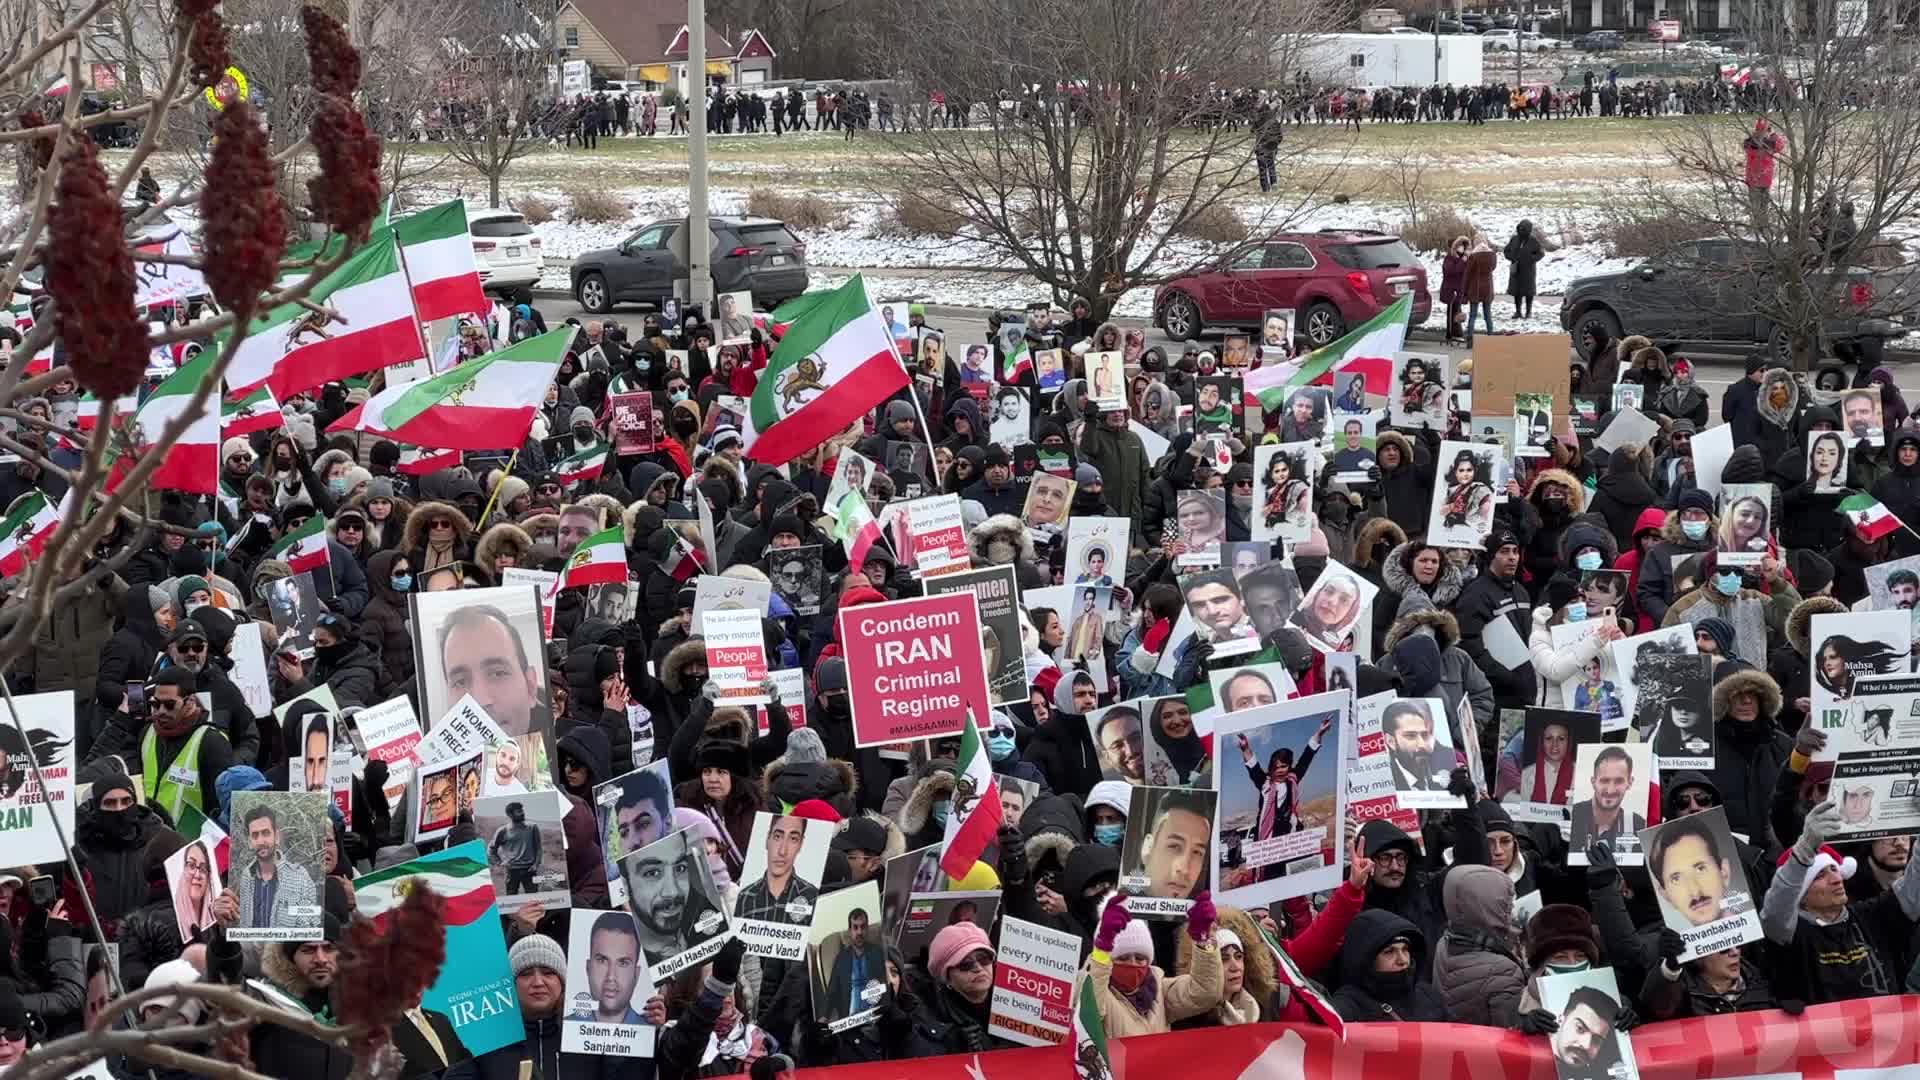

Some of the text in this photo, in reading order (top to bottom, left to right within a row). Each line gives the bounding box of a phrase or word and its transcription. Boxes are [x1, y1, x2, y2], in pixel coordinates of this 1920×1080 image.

[922, 530, 958, 547] People
[861, 611, 960, 637] Condemn
[716, 648, 757, 664] People
[875, 633, 953, 668] IRAN
[1845, 660, 1874, 671] Mahsa
[875, 666, 961, 694] Criminal
[881, 694, 961, 718] Regime
[449, 717, 471, 744] LIFE,
[461, 705, 499, 748] WOMEN
[890, 719, 959, 736] #MAHSAAMINI
[378, 737, 419, 761] People
[1128, 899, 1158, 911] Javad
[740, 922, 802, 941] Amirhossein
[1004, 922, 1078, 953] The list is updated
[1681, 917, 1748, 944] Ravanbakhsh
[776, 944, 800, 958] Vand
[1695, 932, 1744, 956] Emamirad
[657, 938, 726, 978] Majid Hashemi
[1001, 943, 1075, 974] every minute
[1007, 968, 1064, 1000] People
[450, 986, 515, 1028] IRAN
[993, 992, 1071, 1023] are being killed
[580, 1023, 638, 1039] Salem Amir
[994, 1014, 1065, 1044] RIGHT NOW
[583, 1040, 631, 1056] Sanjarian
